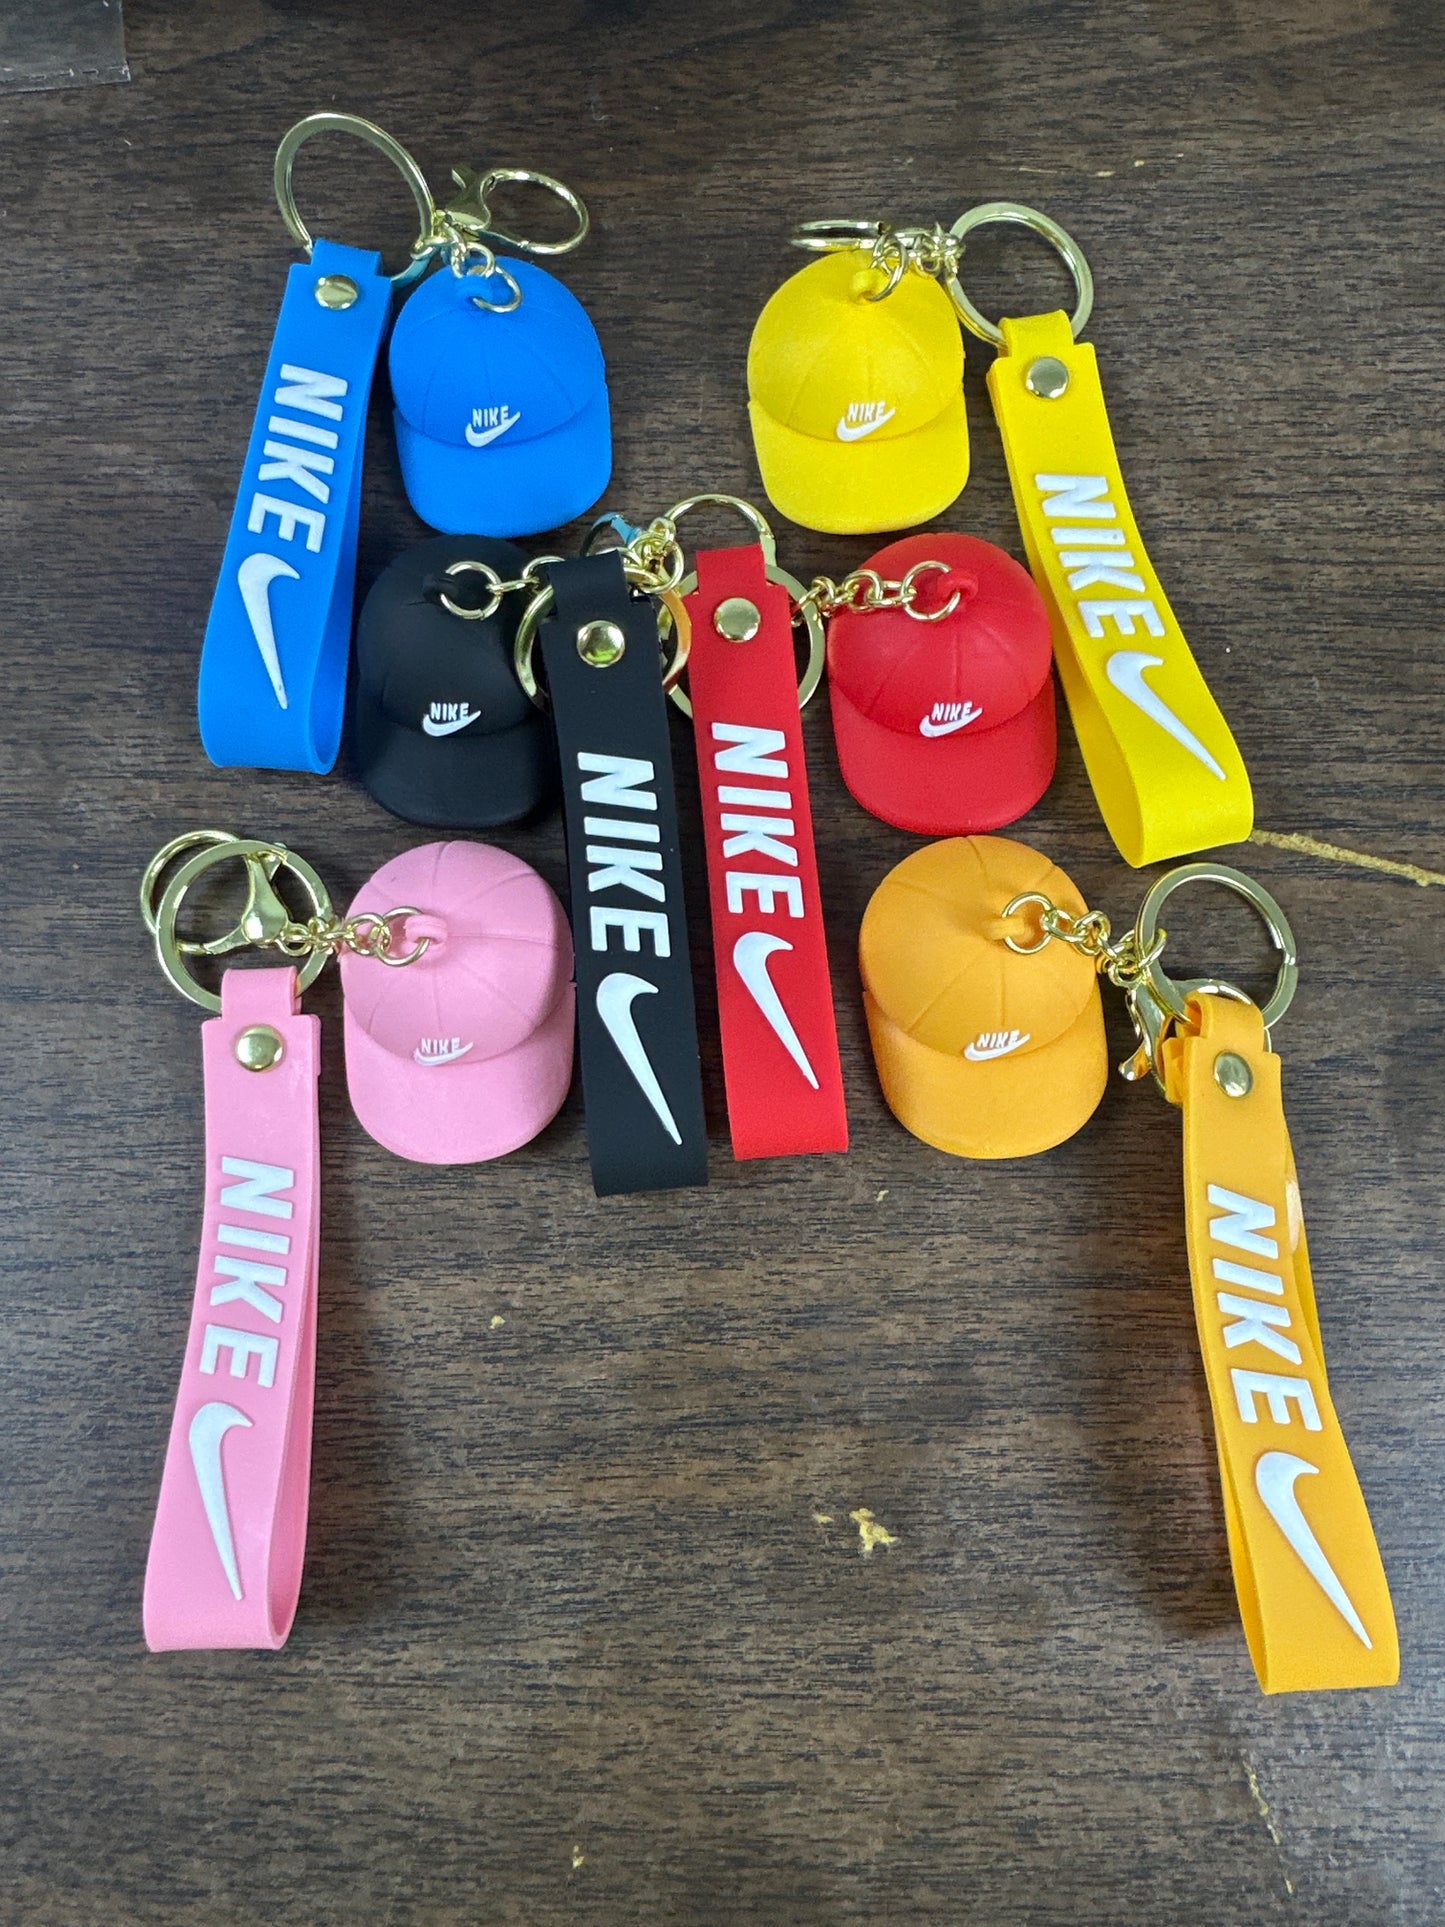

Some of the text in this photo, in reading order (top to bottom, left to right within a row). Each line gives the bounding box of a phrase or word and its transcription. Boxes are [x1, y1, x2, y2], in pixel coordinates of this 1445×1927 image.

[246, 363, 348, 553] NIKE
[472, 405, 509, 428] NIKE
[847, 401, 886, 422] NIKE
[1035, 473, 1167, 639] NIKE
[430, 702, 469, 721] NIKE
[931, 701, 973, 721] NIKE
[577, 751, 671, 959] NIKE
[711, 722, 805, 919] NIKE
[420, 1037, 461, 1054] NIKE
[977, 1030, 1020, 1049] NIKE
[198, 1156, 295, 1389] NIKE
[1207, 1183, 1323, 1433] NIKE
